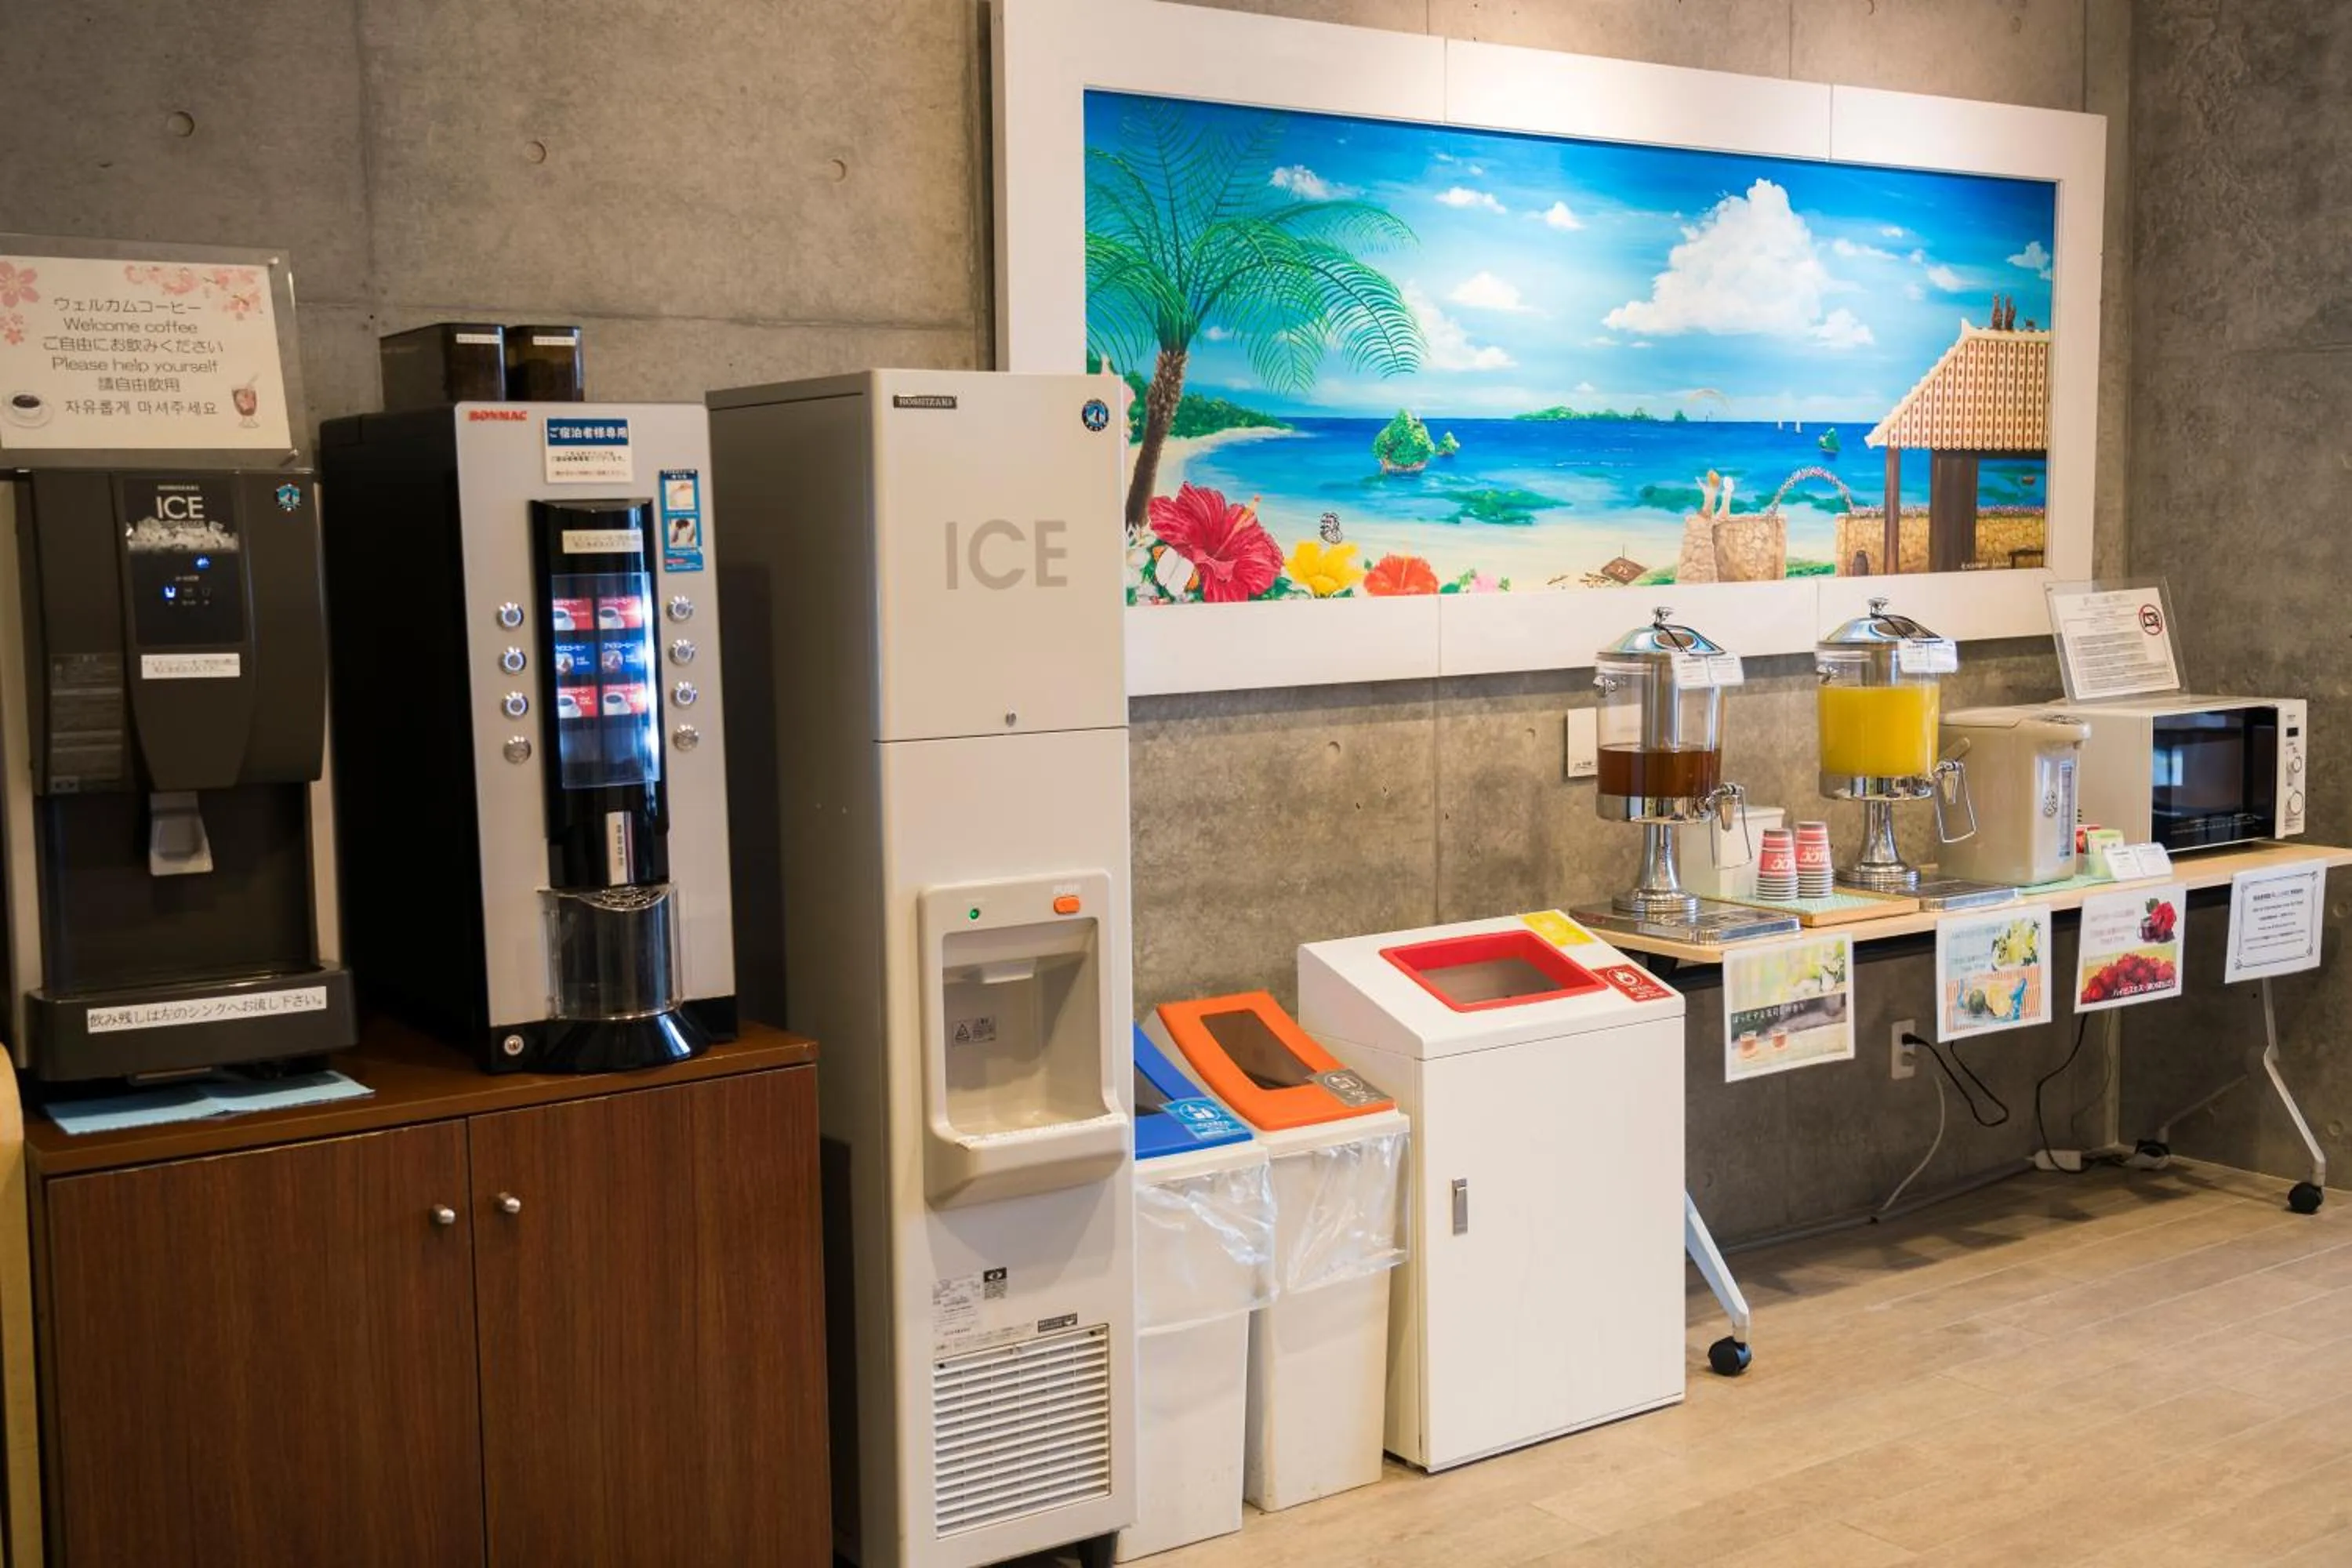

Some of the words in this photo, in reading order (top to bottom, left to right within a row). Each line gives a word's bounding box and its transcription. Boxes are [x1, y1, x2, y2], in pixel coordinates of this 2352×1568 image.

[54, 297, 201, 314] ウェルカムコーヒー
[64, 317, 140, 332] Welcome
[144, 320, 198, 334] coffee
[42, 336, 224, 354] ご自由にお飲みください
[52, 357, 108, 371] Please
[112, 358, 150, 372] help
[154, 359, 220, 374] yourself
[98, 376, 181, 393] 請自由飲用
[65, 399, 131, 416] 자유롭게
[137, 400, 220, 416] 마셔주세요
[156, 495, 205, 520] ICE
[945, 519, 1069, 591] ICE
